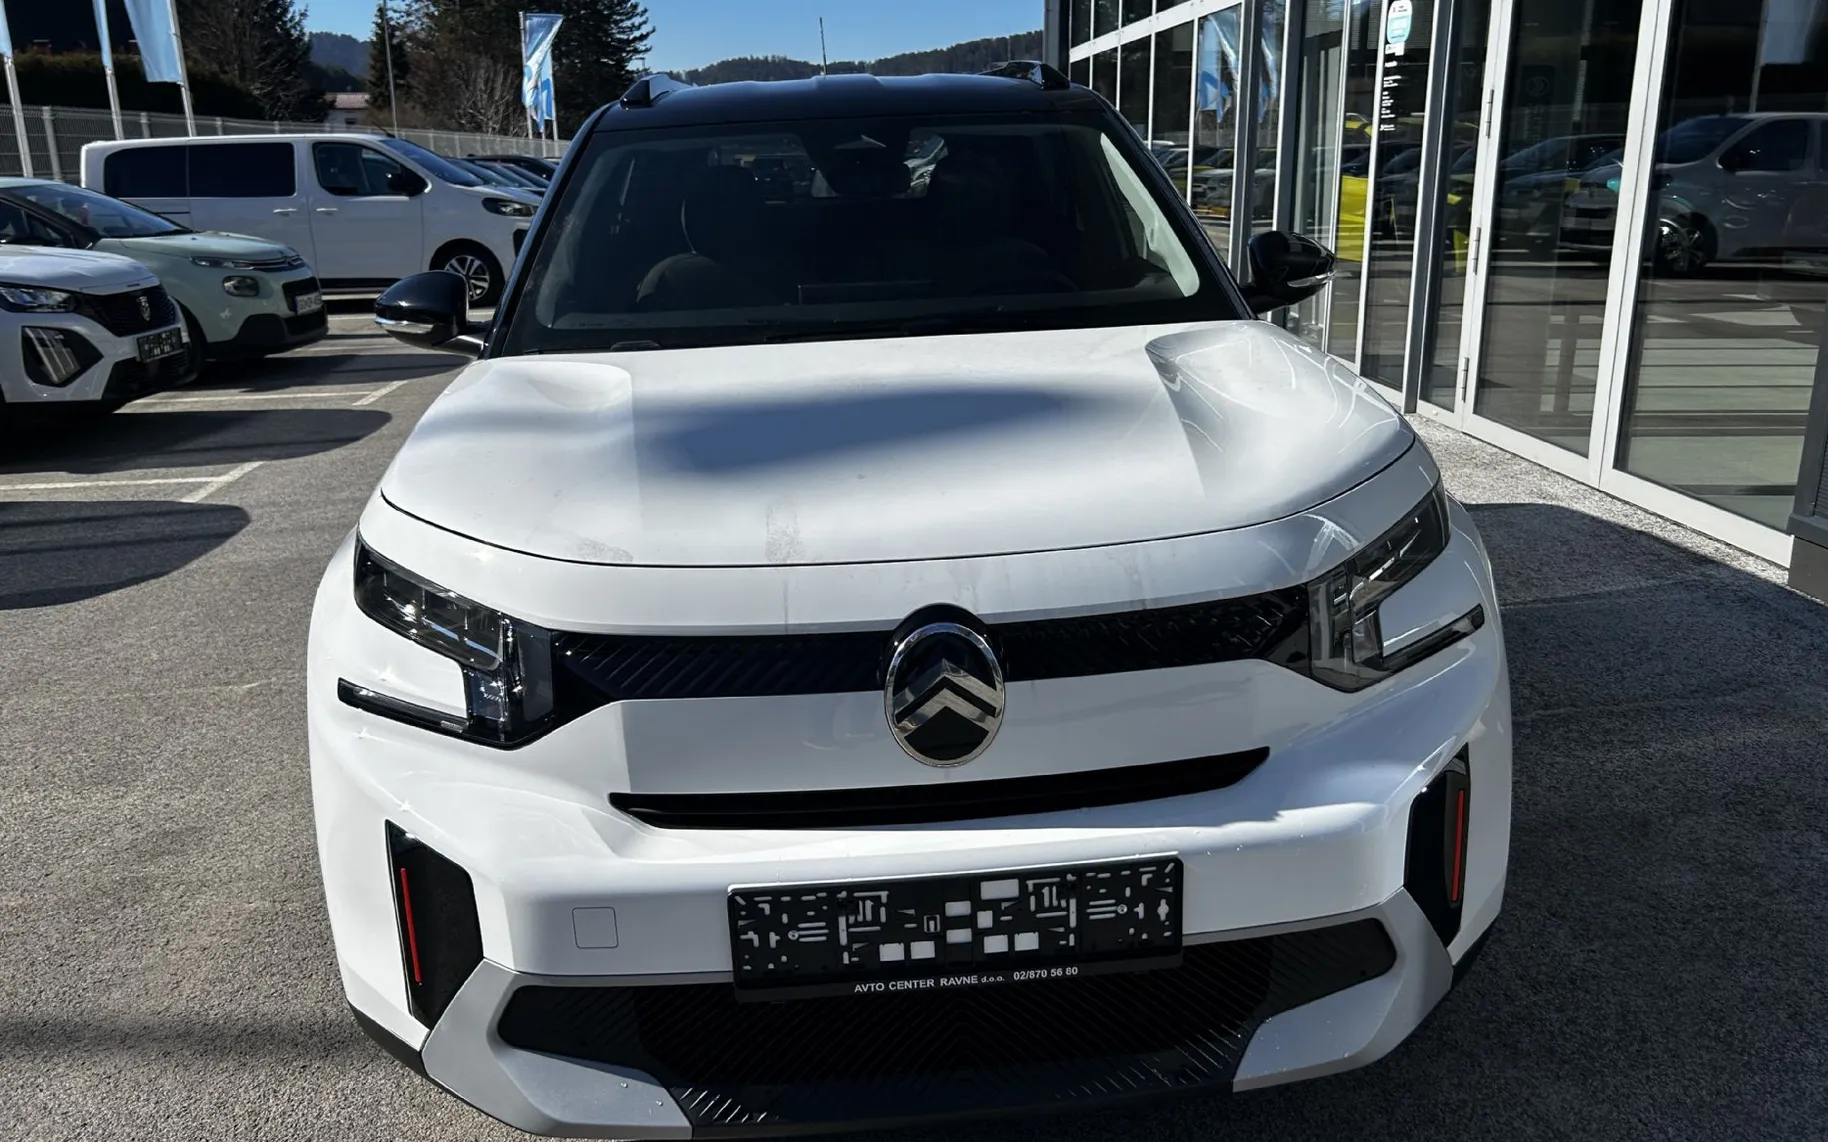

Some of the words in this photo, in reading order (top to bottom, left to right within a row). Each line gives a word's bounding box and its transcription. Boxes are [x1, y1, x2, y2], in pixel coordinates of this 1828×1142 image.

[854, 983, 884, 993] AVTO
[888, 979, 935, 990] CENTER
[940, 975, 978, 987] RAVNE
[980, 975, 1005, 983] d.o.o.
[1013, 969, 1047, 981] 02/870
[1050, 968, 1063, 977] 56
[1065, 966, 1078, 975] 80
